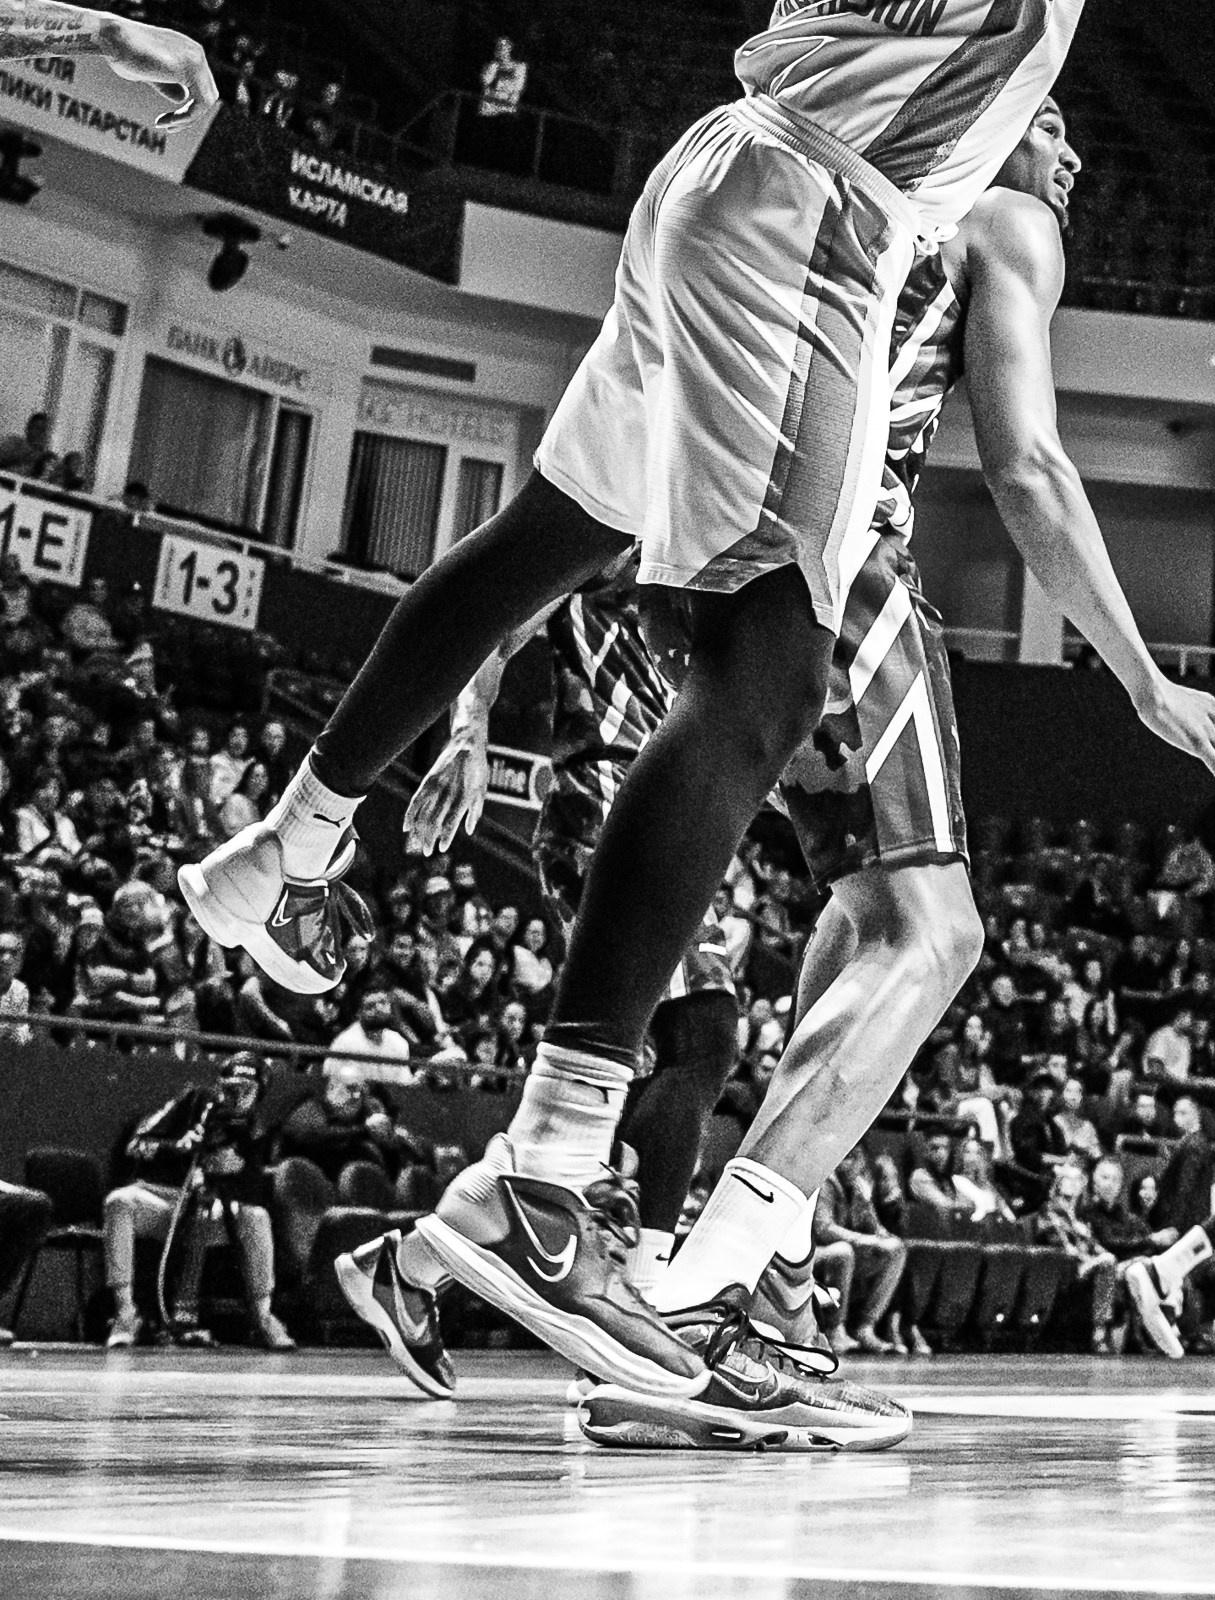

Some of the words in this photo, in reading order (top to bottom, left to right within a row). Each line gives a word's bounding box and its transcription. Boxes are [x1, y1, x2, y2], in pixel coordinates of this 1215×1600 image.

[56, 92, 168, 156] ТАТАРСТАН
[288, 186, 348, 228] КАРТА
[290, 149, 409, 215] ИСЛАМСКАЯ
